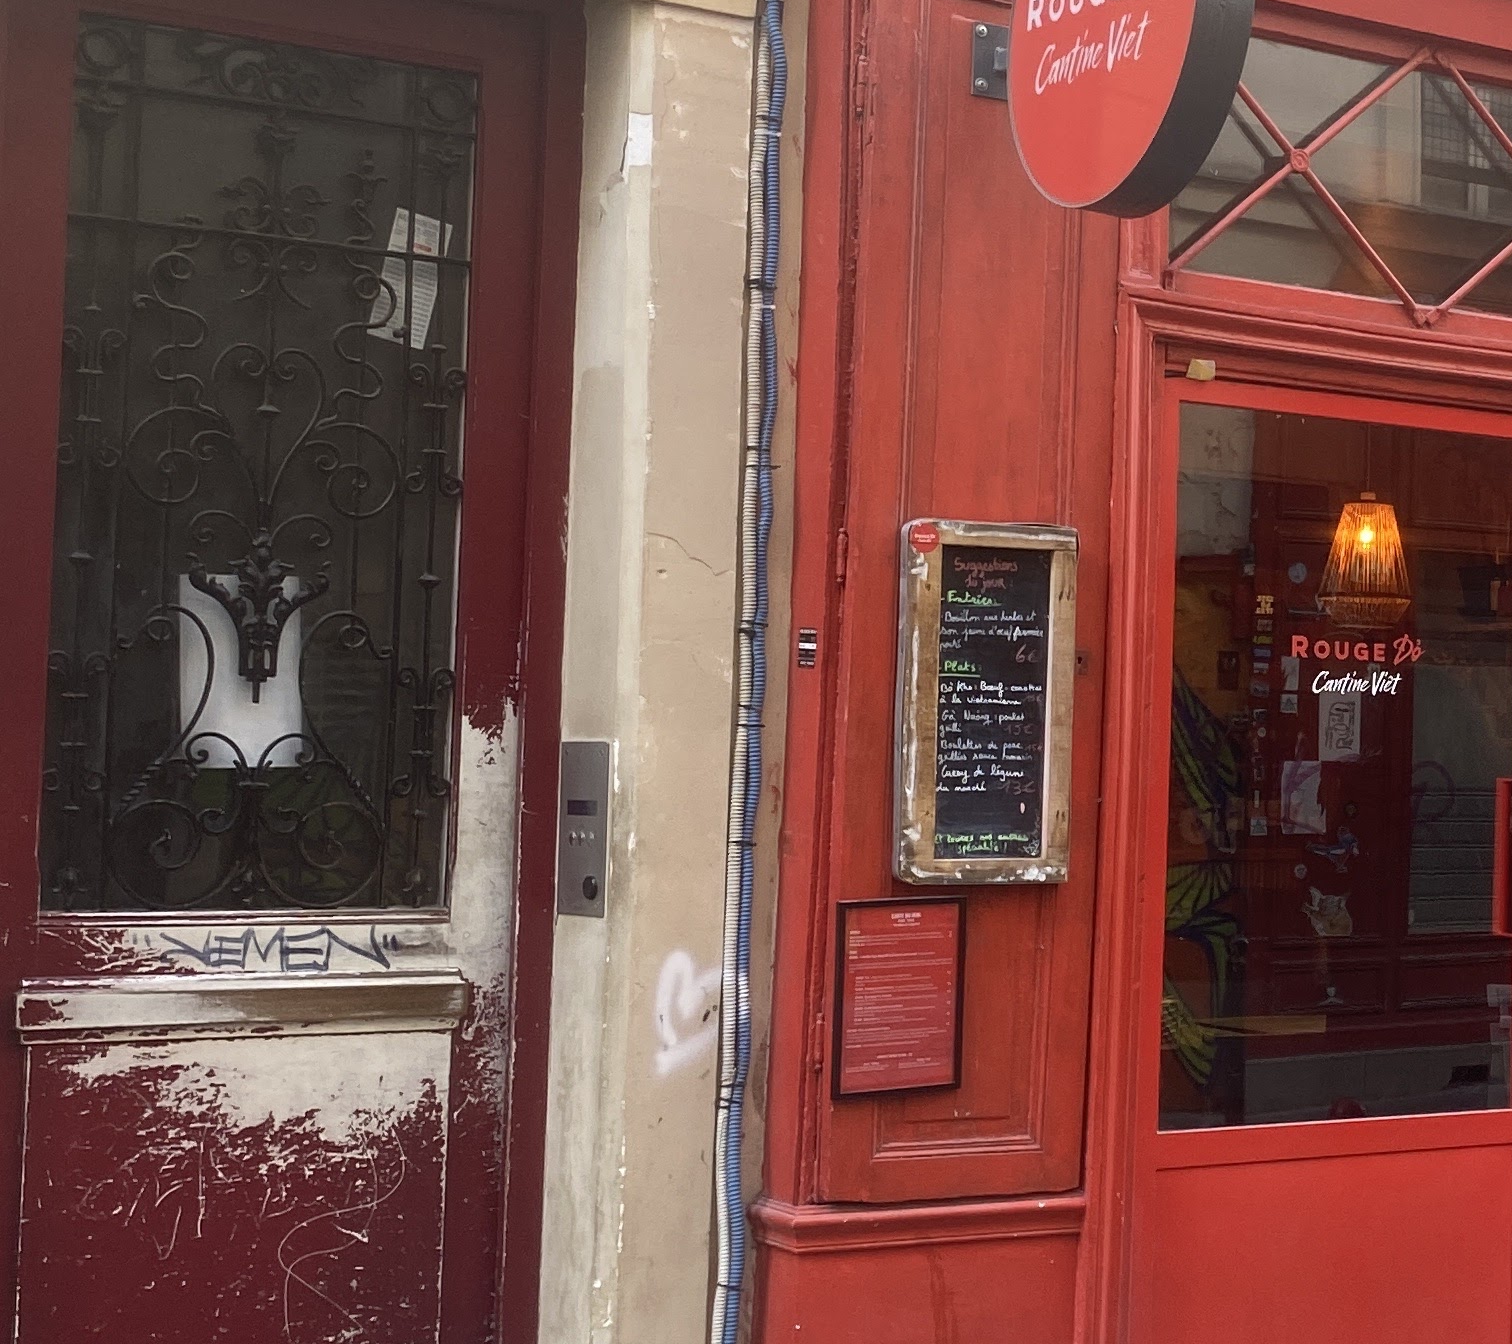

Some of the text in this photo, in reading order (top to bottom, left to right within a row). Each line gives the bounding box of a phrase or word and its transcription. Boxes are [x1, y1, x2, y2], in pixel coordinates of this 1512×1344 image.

[1034, 29, 1104, 95] Cantine
[1025, 610, 1037, 622] et
[1291, 635, 1386, 662] ROUGE
[1311, 670, 1402, 696] Cantine Viêt
[951, 693, 962, 704] la
[987, 741, 999, 750] de
